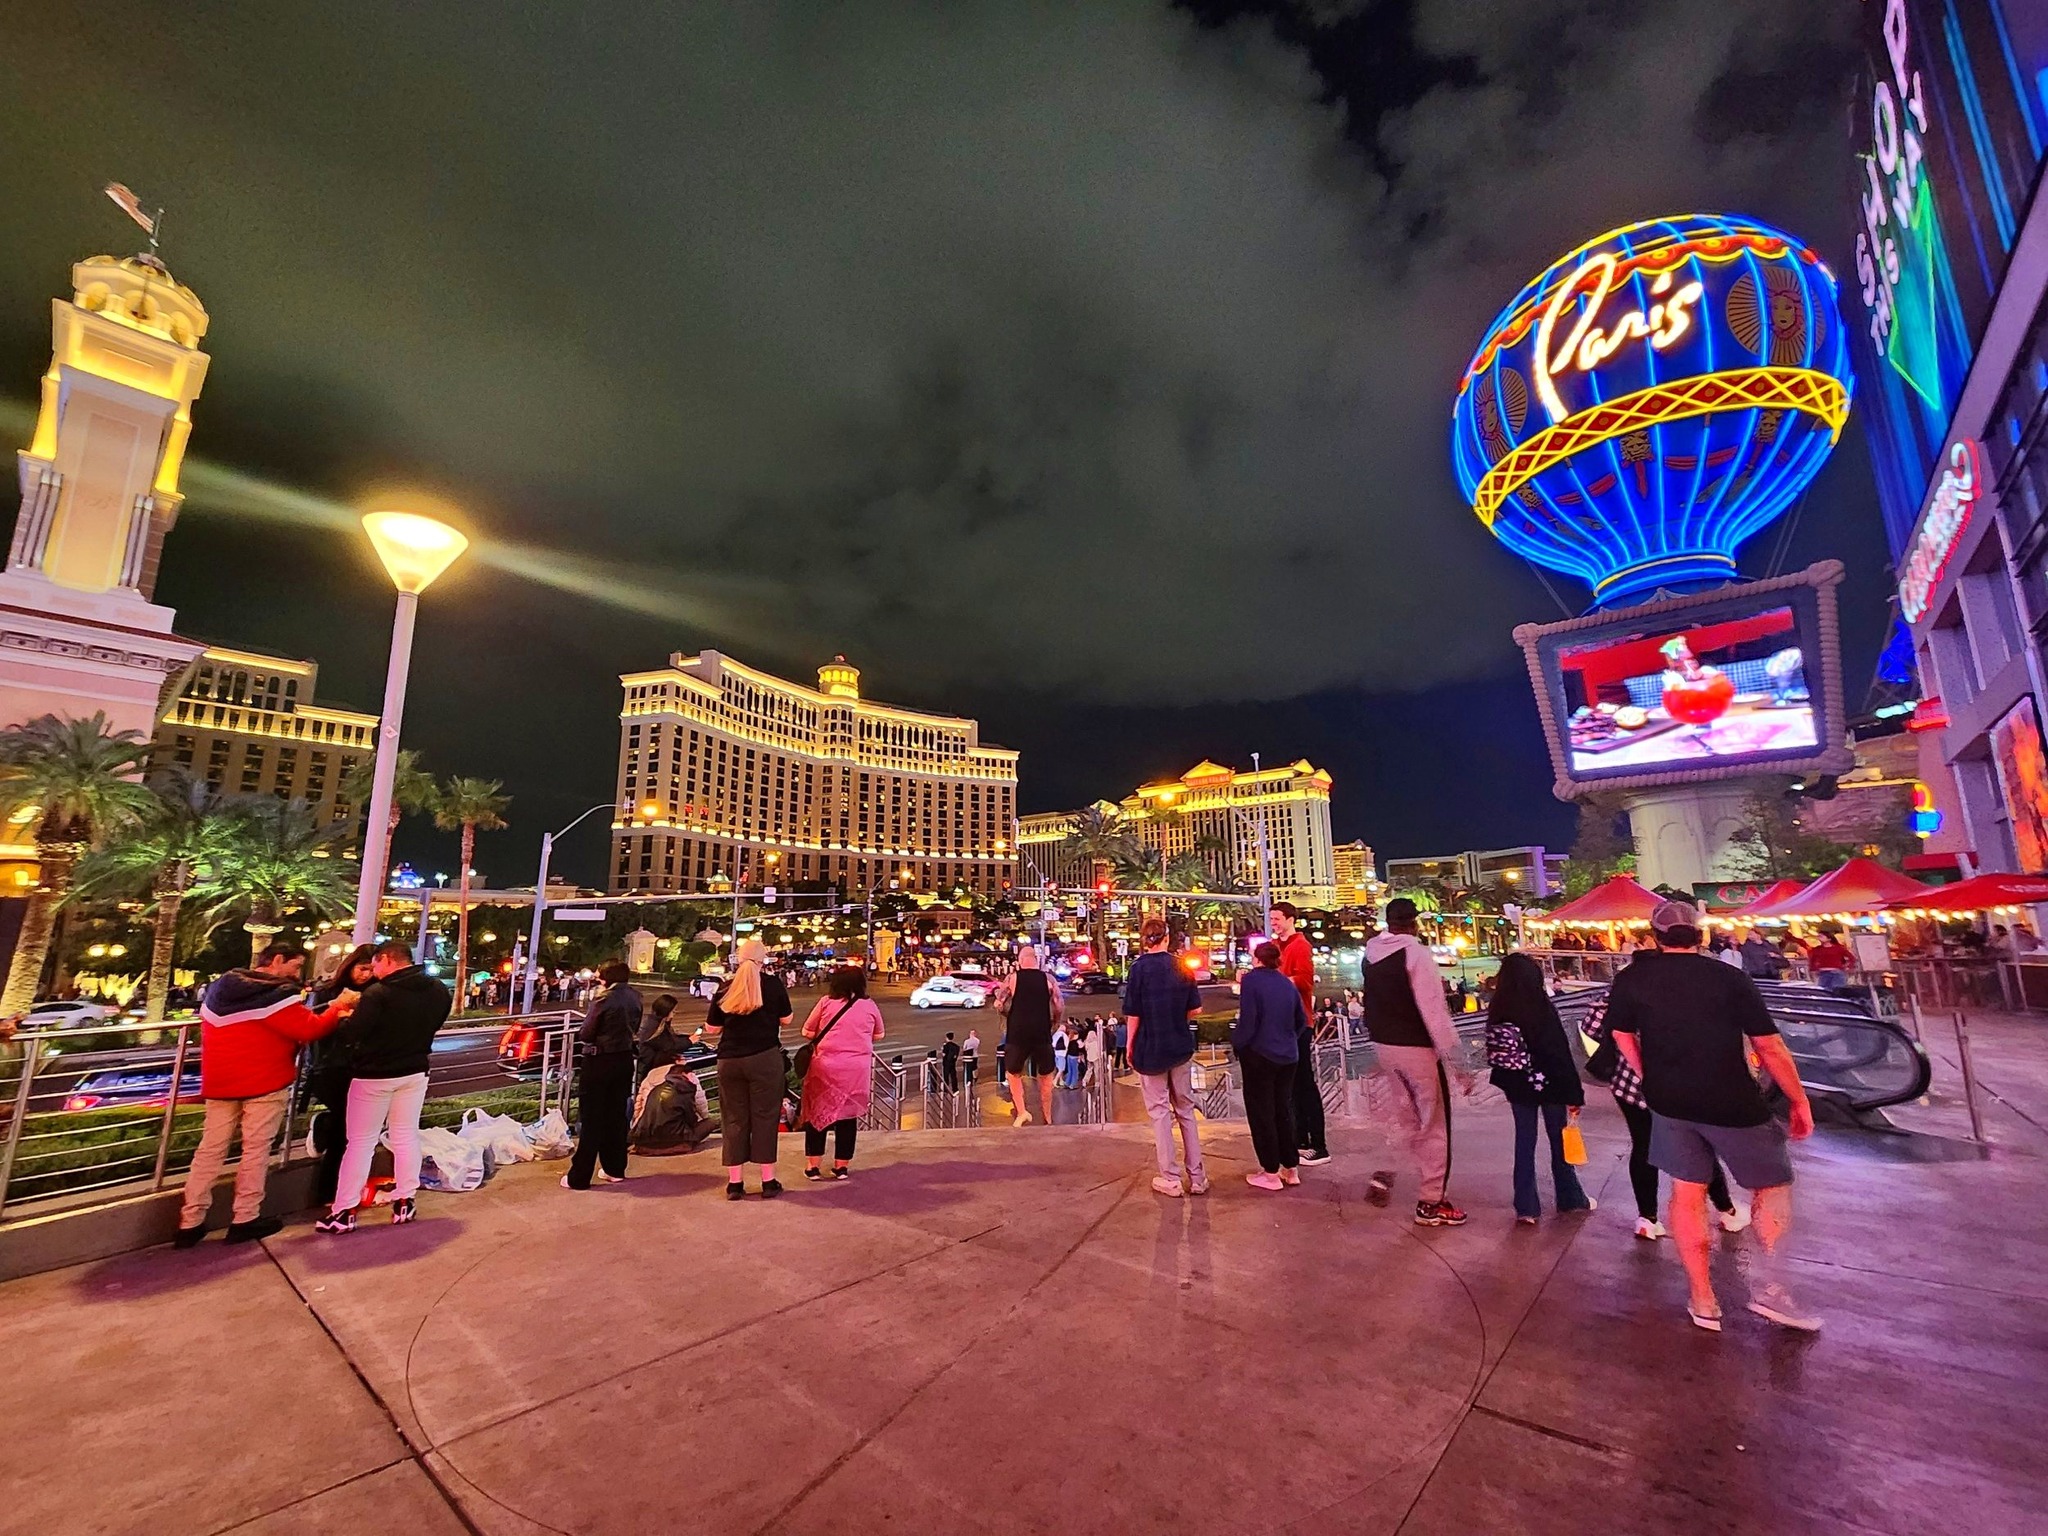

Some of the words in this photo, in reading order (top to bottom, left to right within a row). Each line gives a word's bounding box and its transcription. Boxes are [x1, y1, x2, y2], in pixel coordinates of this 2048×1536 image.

[1870, 238, 1899, 357] THIS
[1893, 71, 1927, 229] WAY
[1535, 253, 1703, 423] Paris
